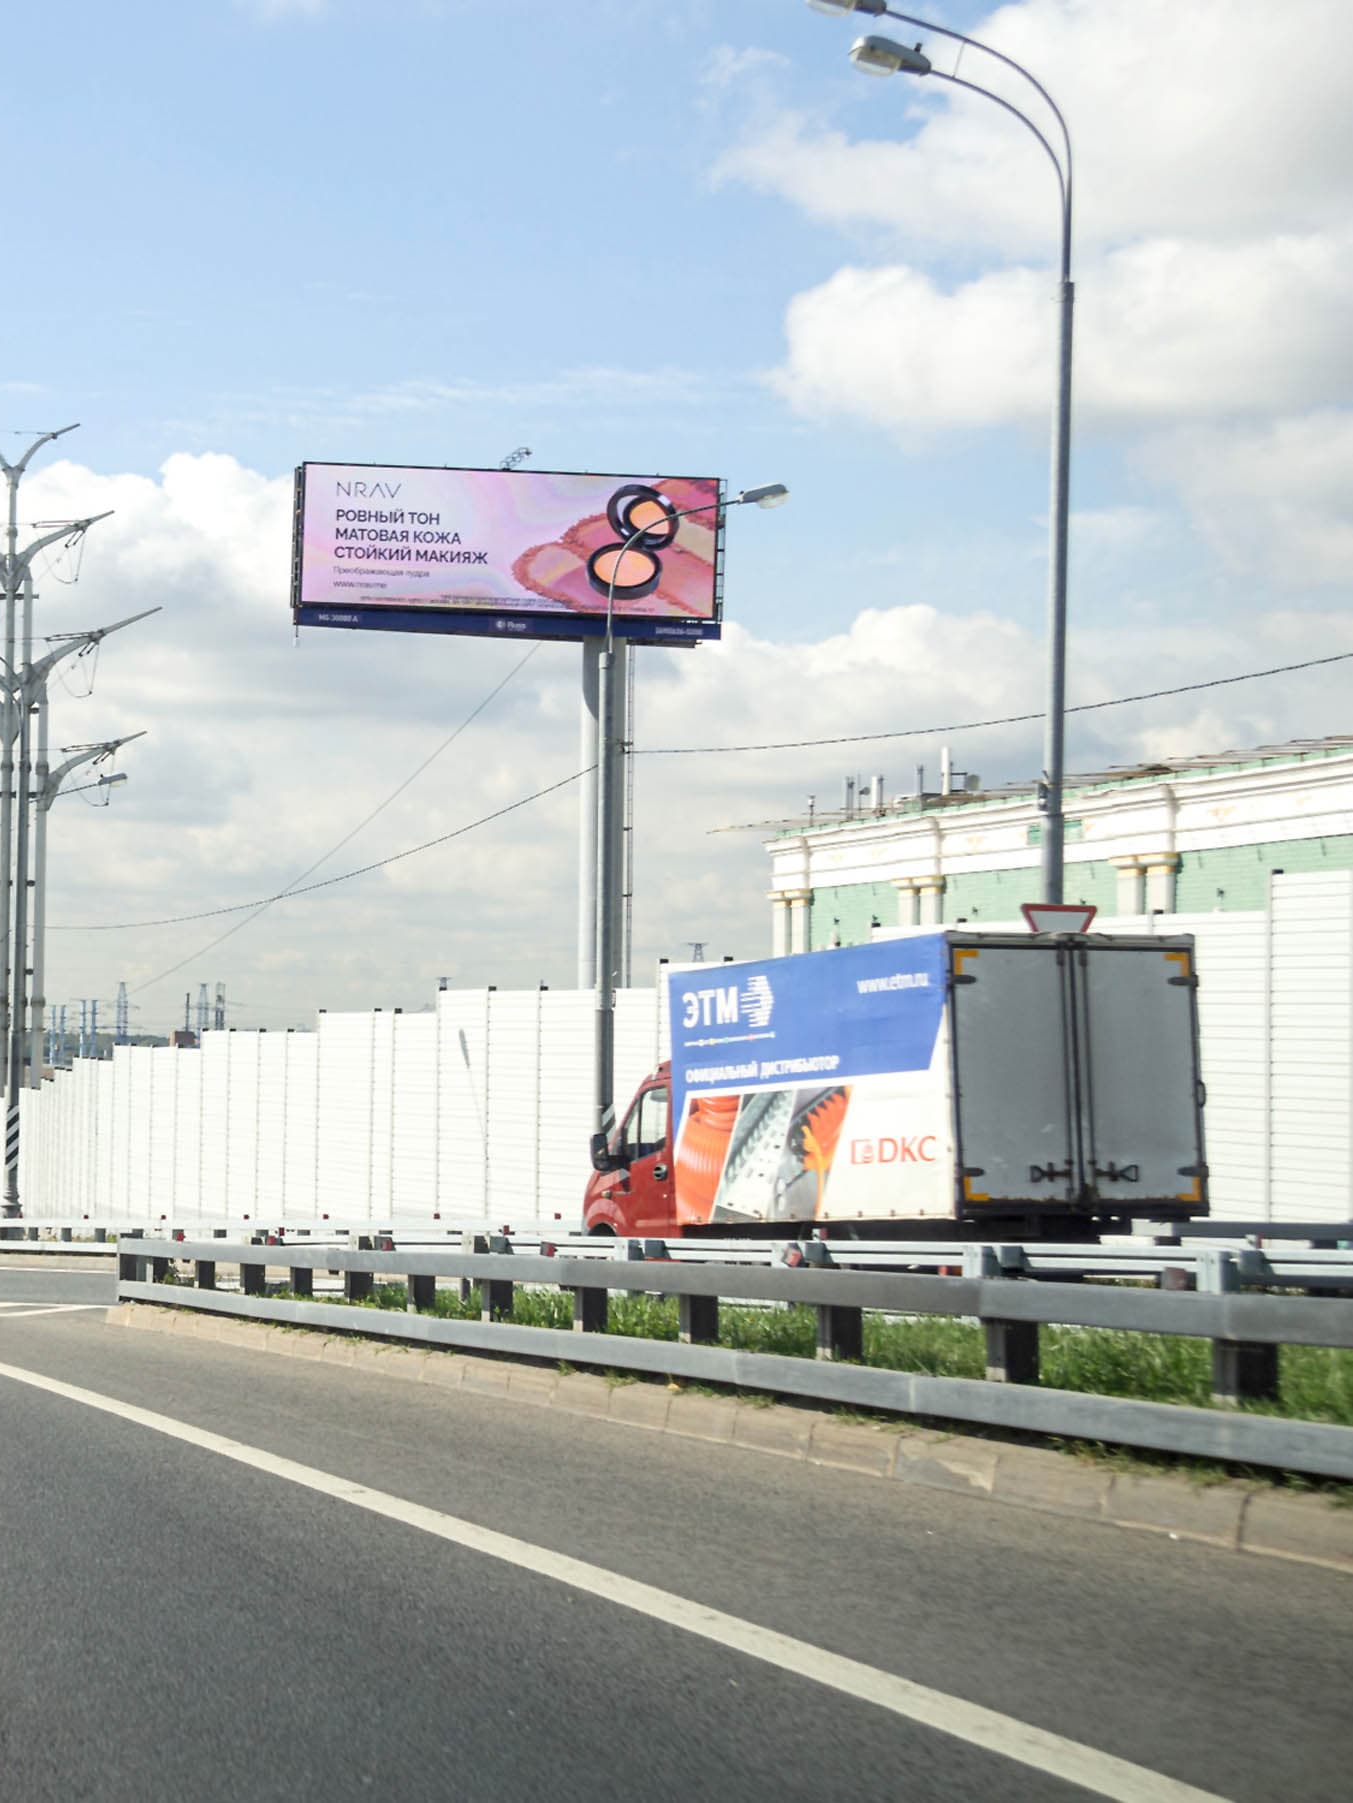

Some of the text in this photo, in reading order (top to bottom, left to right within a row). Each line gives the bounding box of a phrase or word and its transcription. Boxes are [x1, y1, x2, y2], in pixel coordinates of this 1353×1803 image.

[336, 481, 402, 499] NRAV
[336, 508, 440, 525] РОВНЫЙ ТОН
[335, 527, 462, 545] МАТОВАЯ КОЖА
[334, 544, 488, 565] СТОЙКИЙ МАКИЯЖ
[856, 972, 930, 995] www.etm.ru
[681, 986, 739, 1029] ЭТМ
[685, 1055, 840, 1084] ОФИЦИАЛЬНЫЙ ДИСТРИБЬЮТОР
[878, 1135, 937, 1163] DKC
